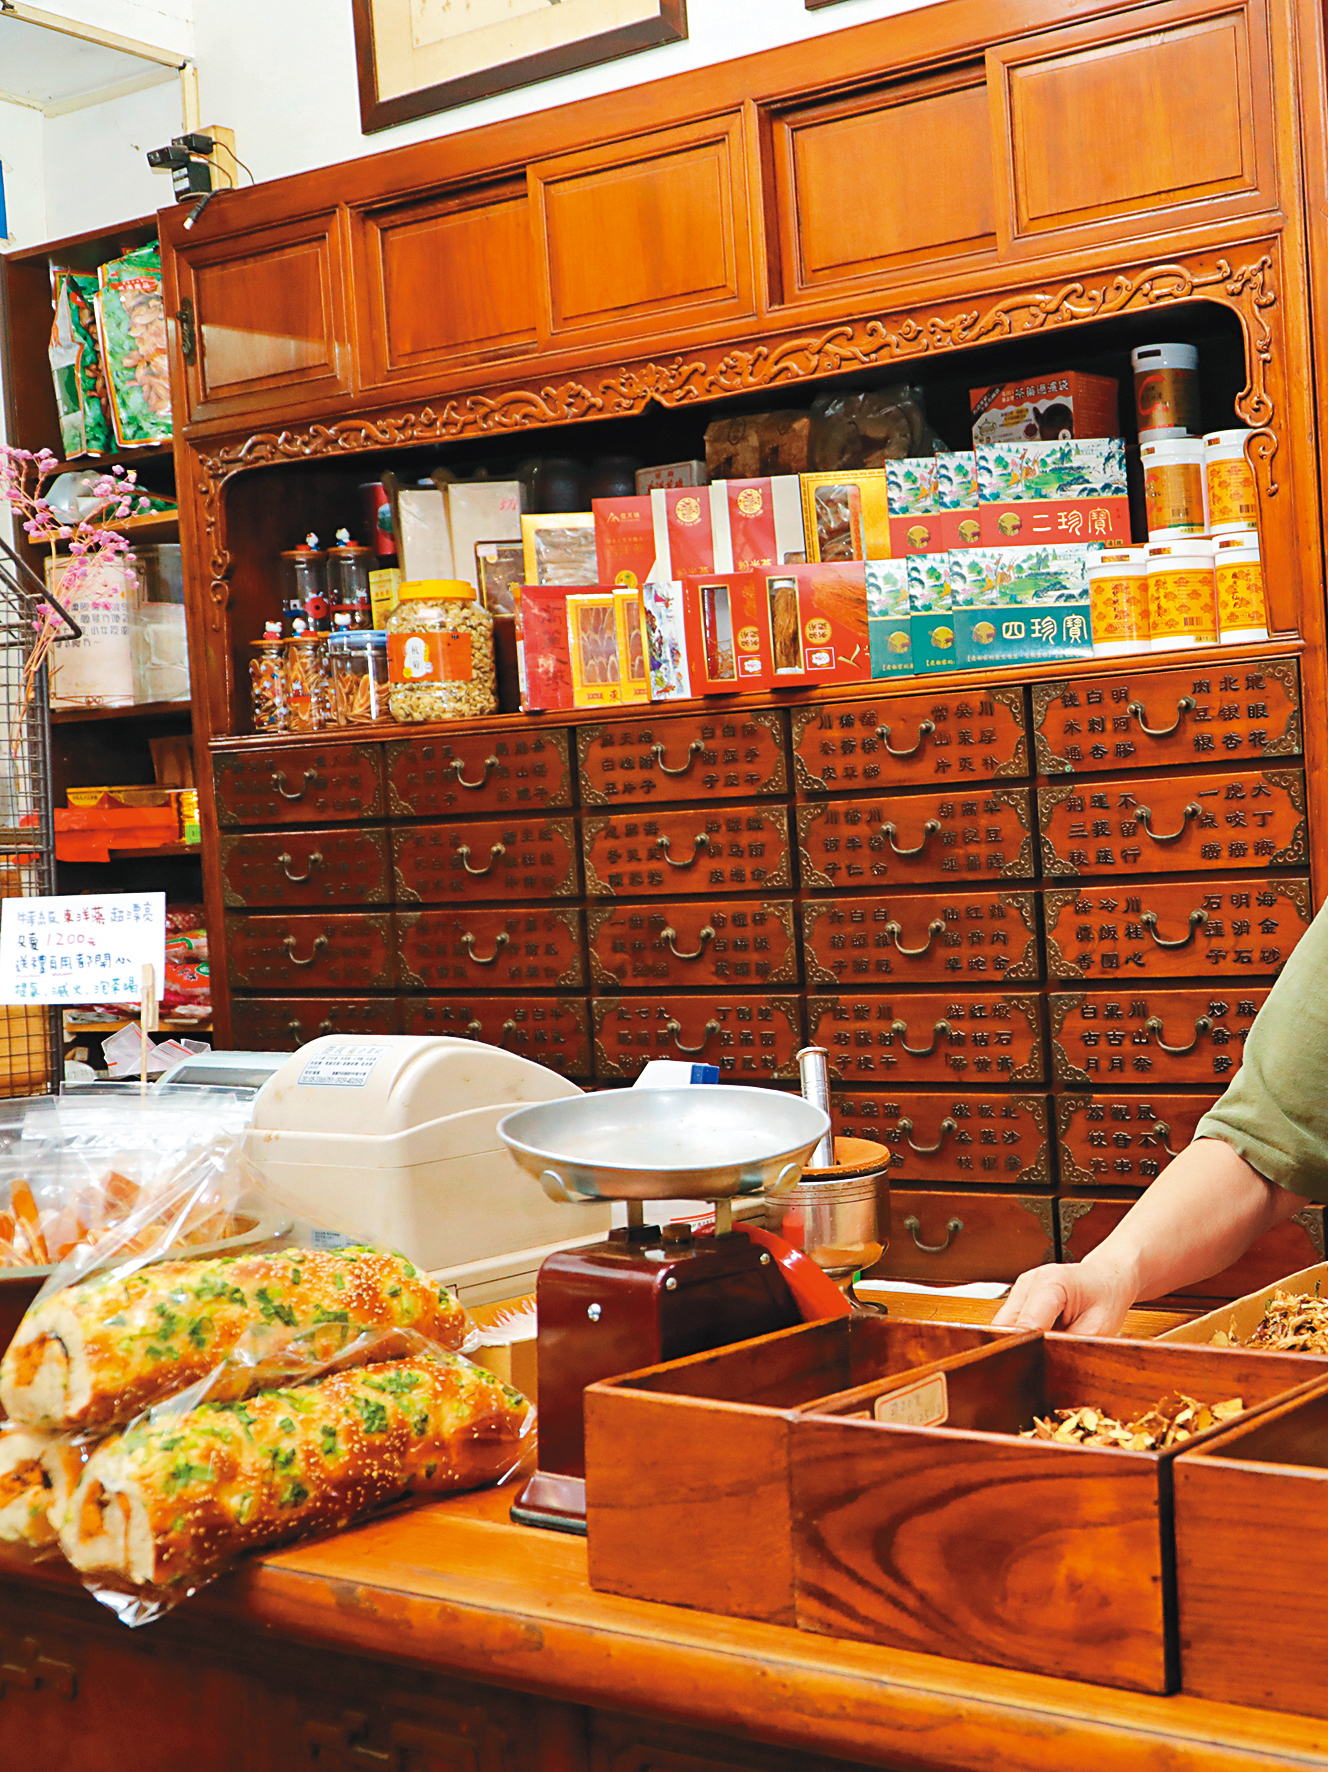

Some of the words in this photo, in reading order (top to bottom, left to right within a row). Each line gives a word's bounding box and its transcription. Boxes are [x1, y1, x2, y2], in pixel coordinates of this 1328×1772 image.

[1032, 508, 1113, 535] 二珍寶
[1002, 614, 1087, 642] 四珍寶
[18, 910, 59, 925] 特級
